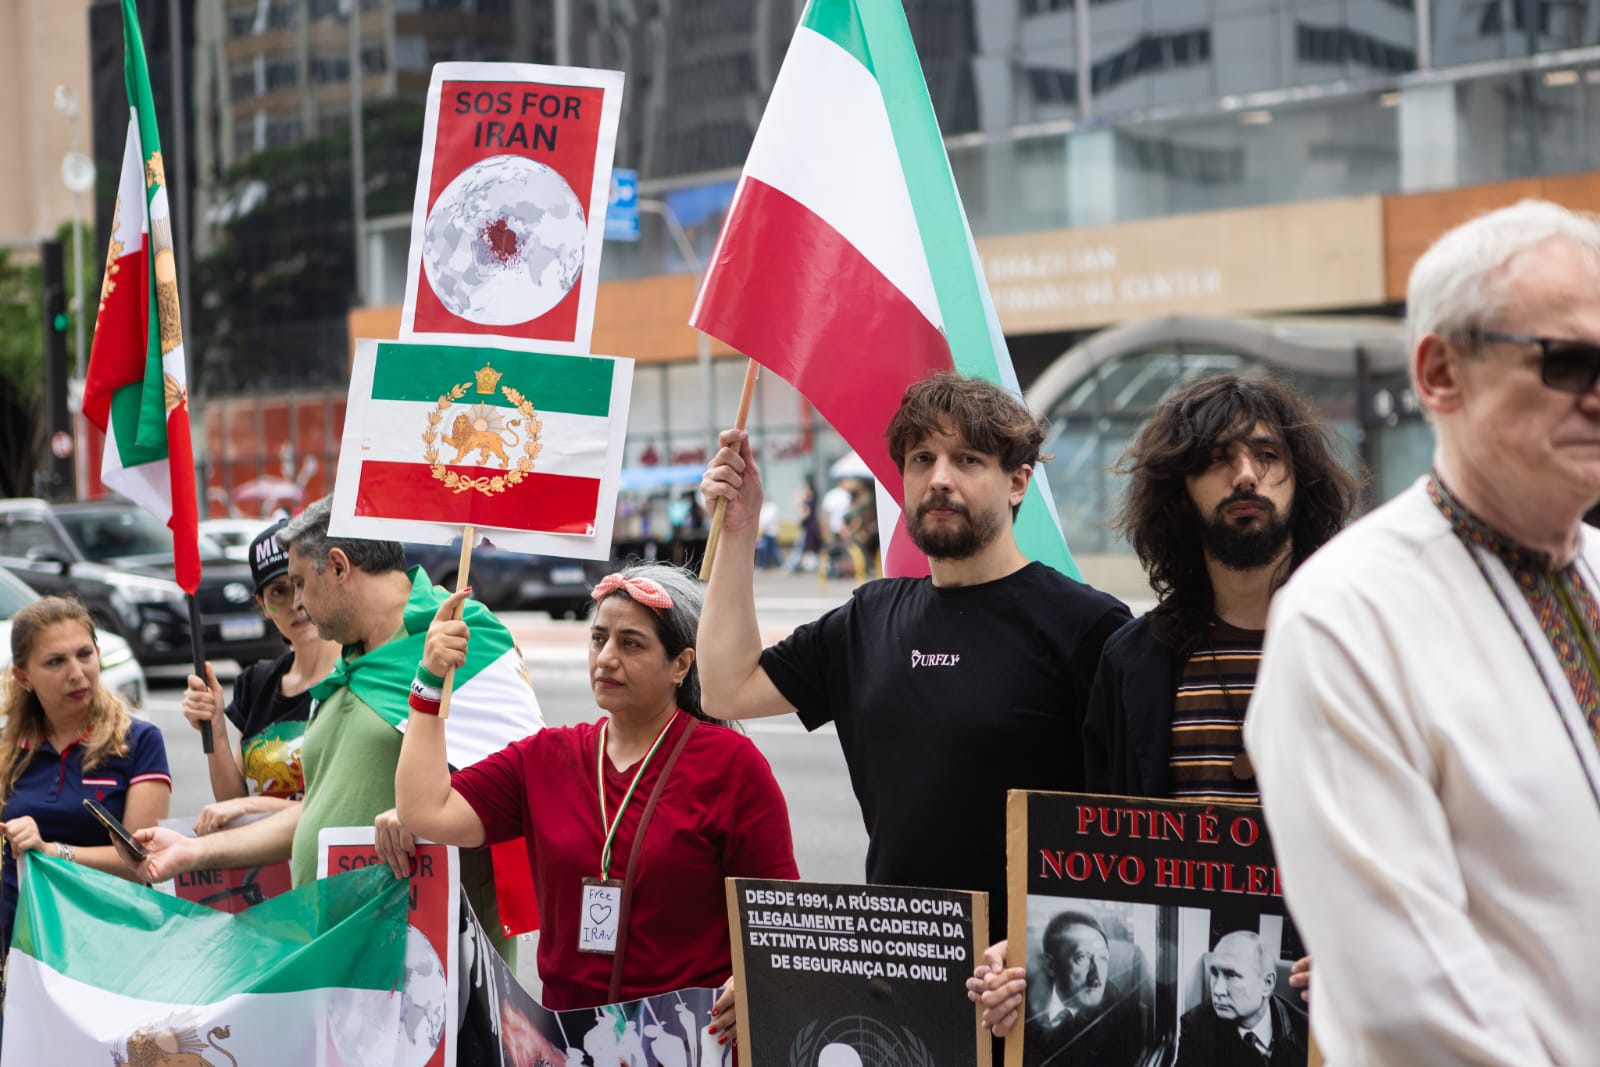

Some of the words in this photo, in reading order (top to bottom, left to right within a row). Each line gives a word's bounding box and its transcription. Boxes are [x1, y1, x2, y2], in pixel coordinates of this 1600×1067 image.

[455, 91, 512, 114] SOS
[521, 92, 581, 119] FOR
[474, 121, 557, 152] IRAN
[1076, 805, 1186, 842] PUTIN
[1196, 805, 1221, 844] É
[1230, 816, 1260, 847] O
[178, 869, 224, 887] LINE
[1040, 849, 1146, 885] NOVO
[589, 888, 613, 901] Free
[745, 890, 795, 906] DESDE
[796, 893, 833, 911] 1991,
[835, 895, 847, 909] A
[848, 891, 908, 913] RÚSSIA
[910, 898, 964, 917] OCUPA
[584, 926, 616, 942] IRAN
[748, 910, 855, 931] ILEGALMENTE
[857, 917, 868, 932] A
[870, 918, 941, 937] CADEIRA
[943, 922, 964, 939] DA
[749, 932, 817, 950] EXTINTA
[818, 936, 859, 953] URSS
[861, 939, 883, 954] NO
[885, 941, 966, 961] CONSELHO
[771, 954, 791, 969] DE
[793, 956, 884, 980] SEGURANÇA
[886, 962, 908, 979] DA
[910, 964, 948, 982] ONU!
